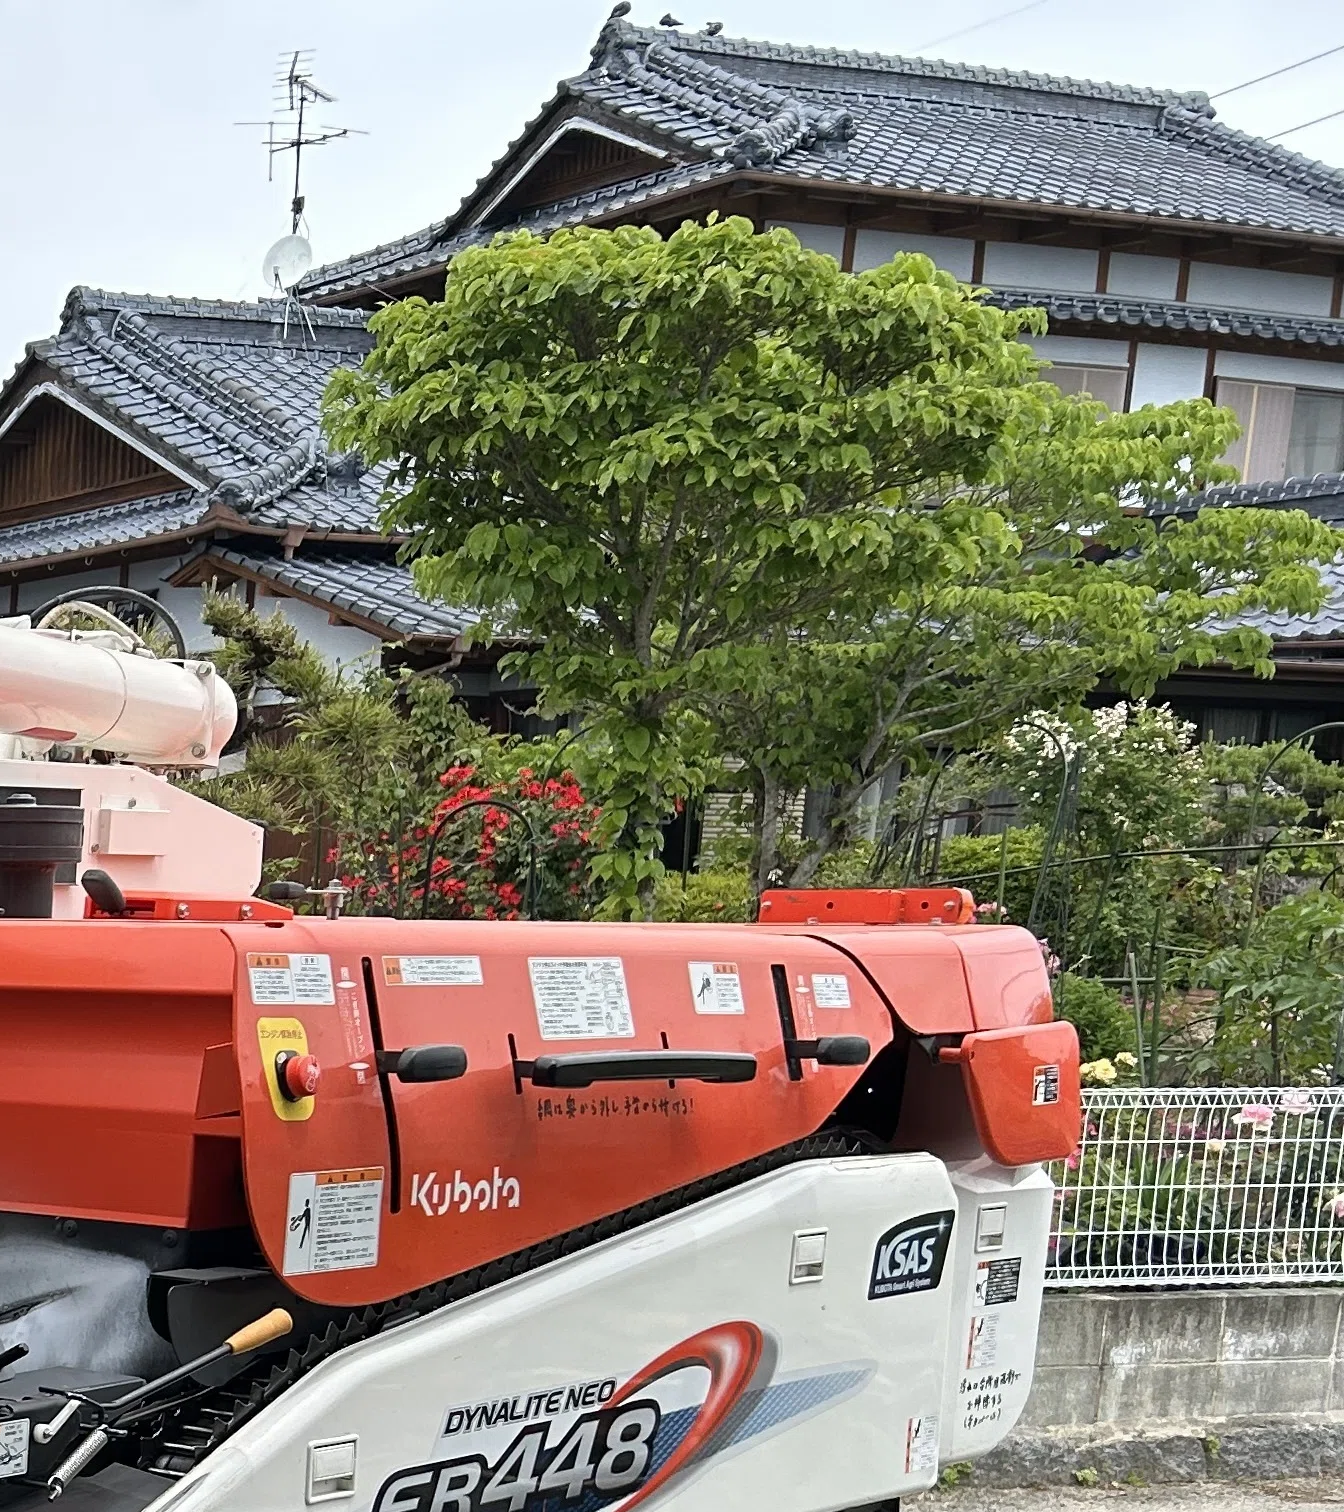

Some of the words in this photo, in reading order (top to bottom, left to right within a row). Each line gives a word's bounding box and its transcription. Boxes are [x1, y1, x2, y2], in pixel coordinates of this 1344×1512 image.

[410, 1166, 521, 1217] Kubota
[876, 1237, 936, 1280] KSAS
[444, 1388, 563, 1436] DYNALITE
[565, 1378, 617, 1412] NEO
